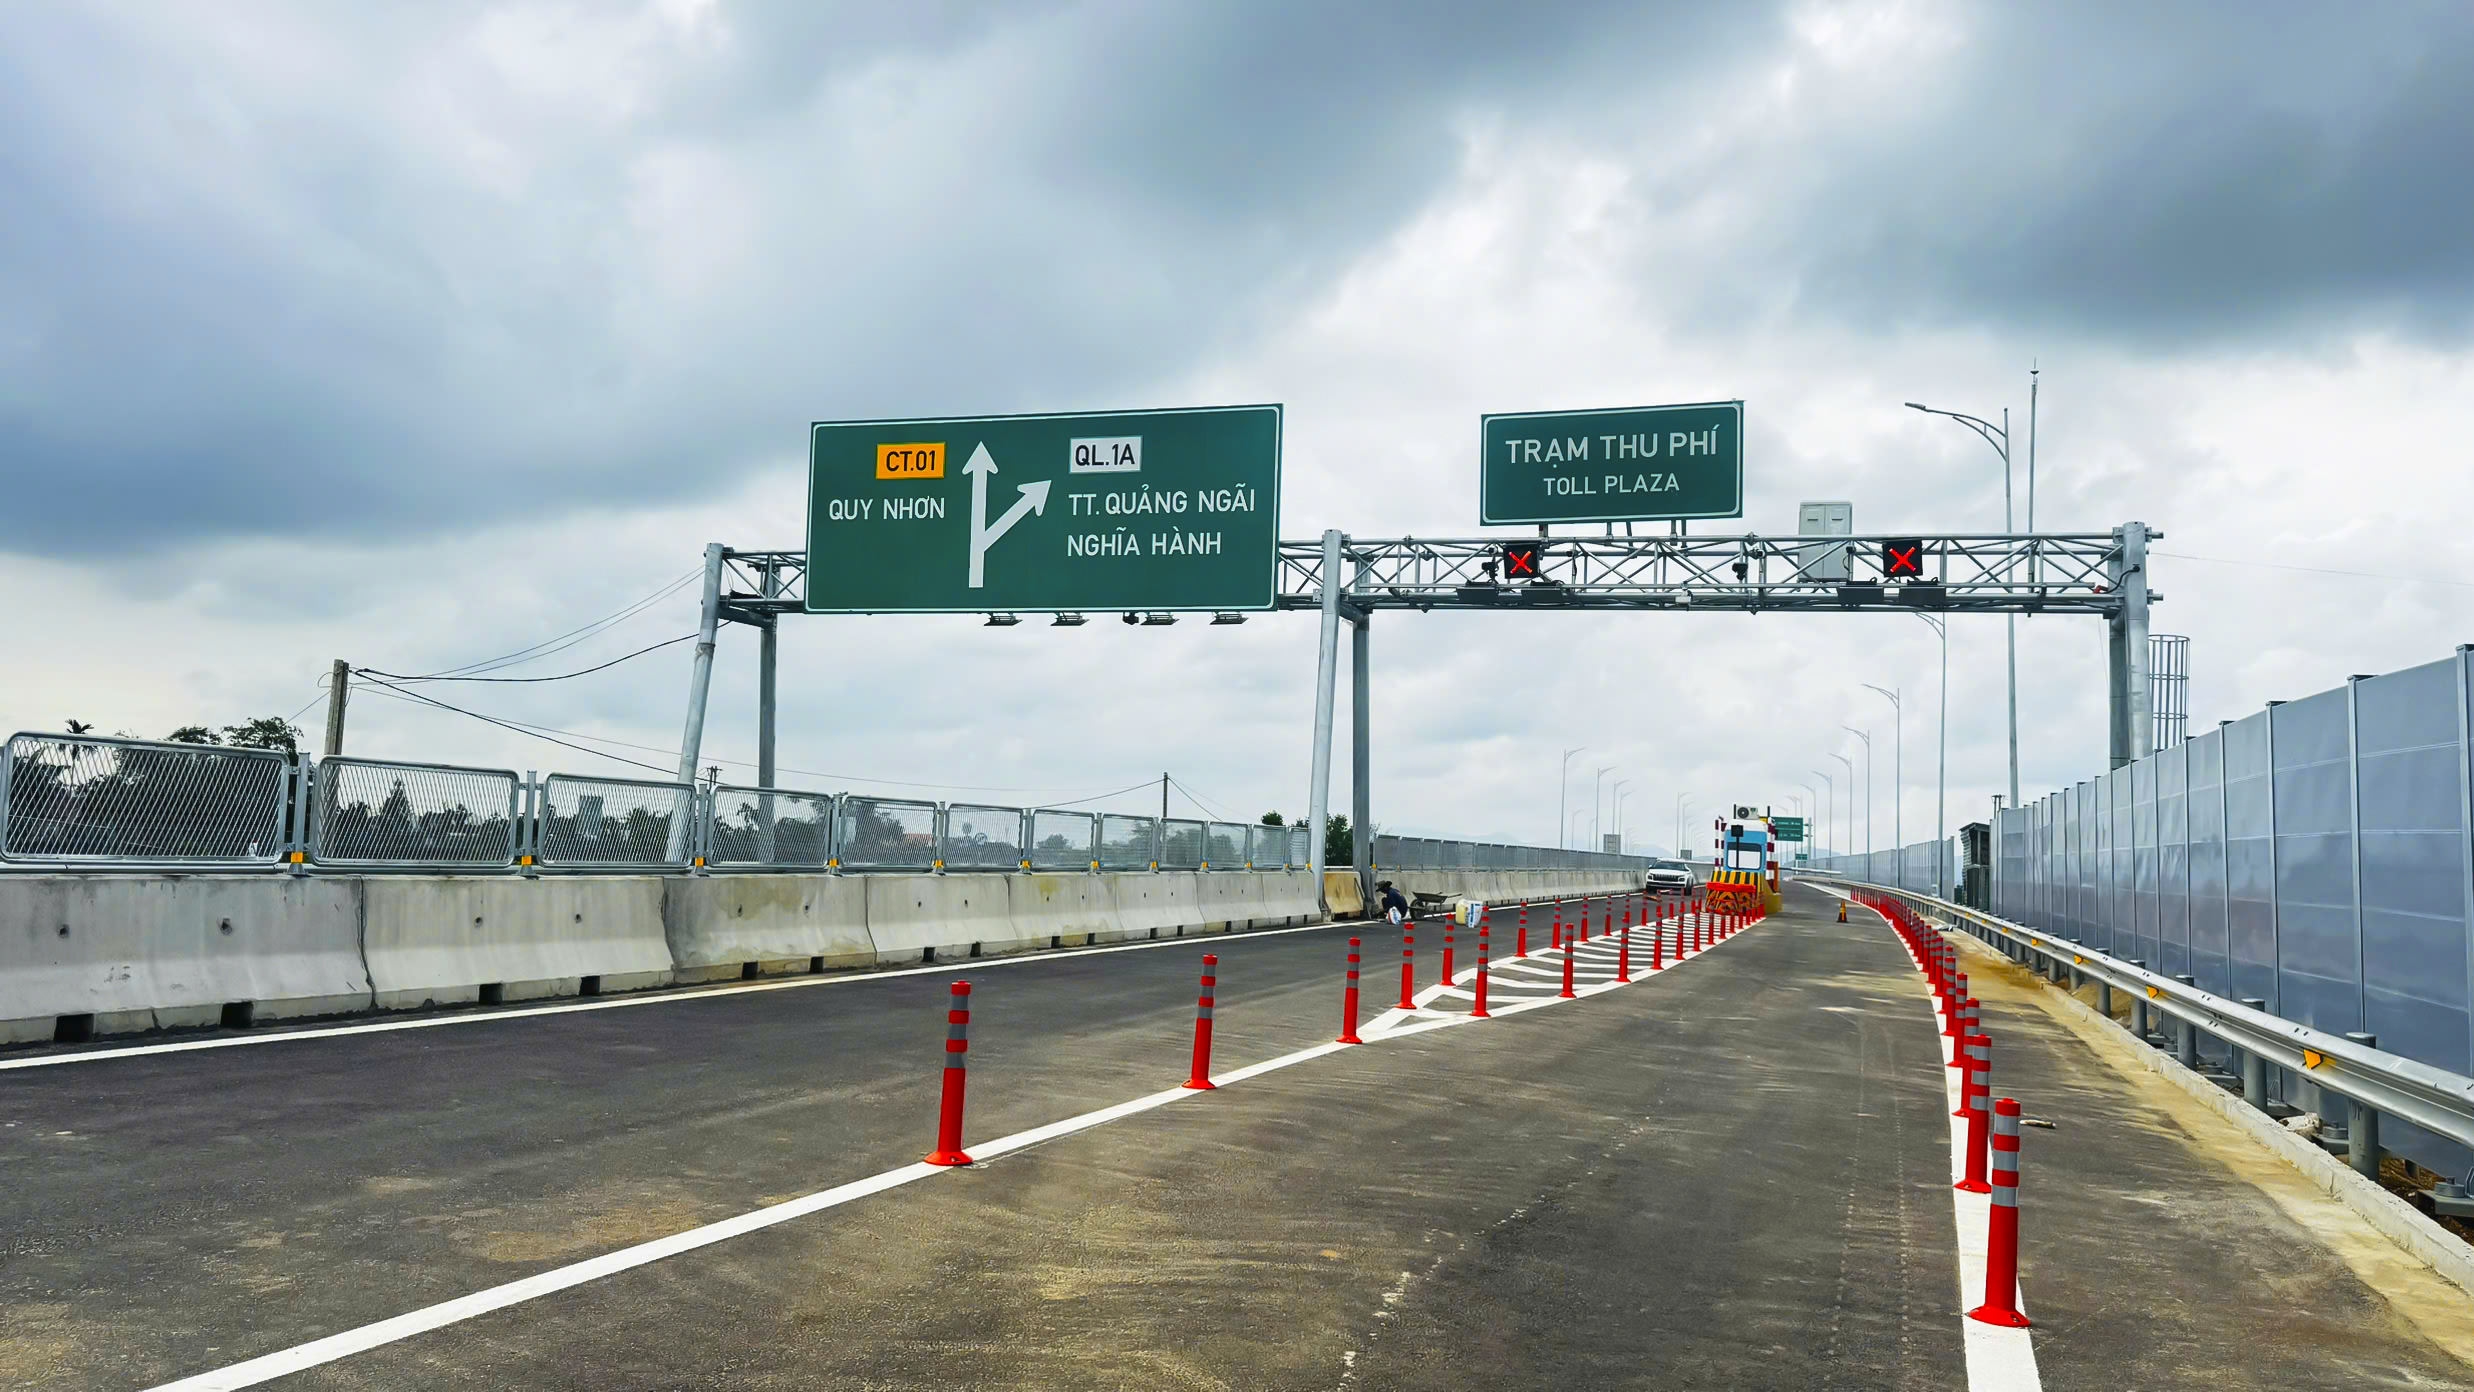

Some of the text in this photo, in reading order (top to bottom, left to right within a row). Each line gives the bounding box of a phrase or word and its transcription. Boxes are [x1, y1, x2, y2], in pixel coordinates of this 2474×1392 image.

[1075, 443, 1136, 467] QL.1A
[1505, 423, 1720, 469] TRẠM THU PHÍ
[886, 449, 936, 472] CT.01
[1543, 472, 1680, 496] TOLL PLAZA
[829, 495, 945, 521] QUY NHƠN
[1068, 482, 1255, 516] TT. QUẢNG NGÃI
[1067, 525, 1221, 557] NGHĨA HÀNH
